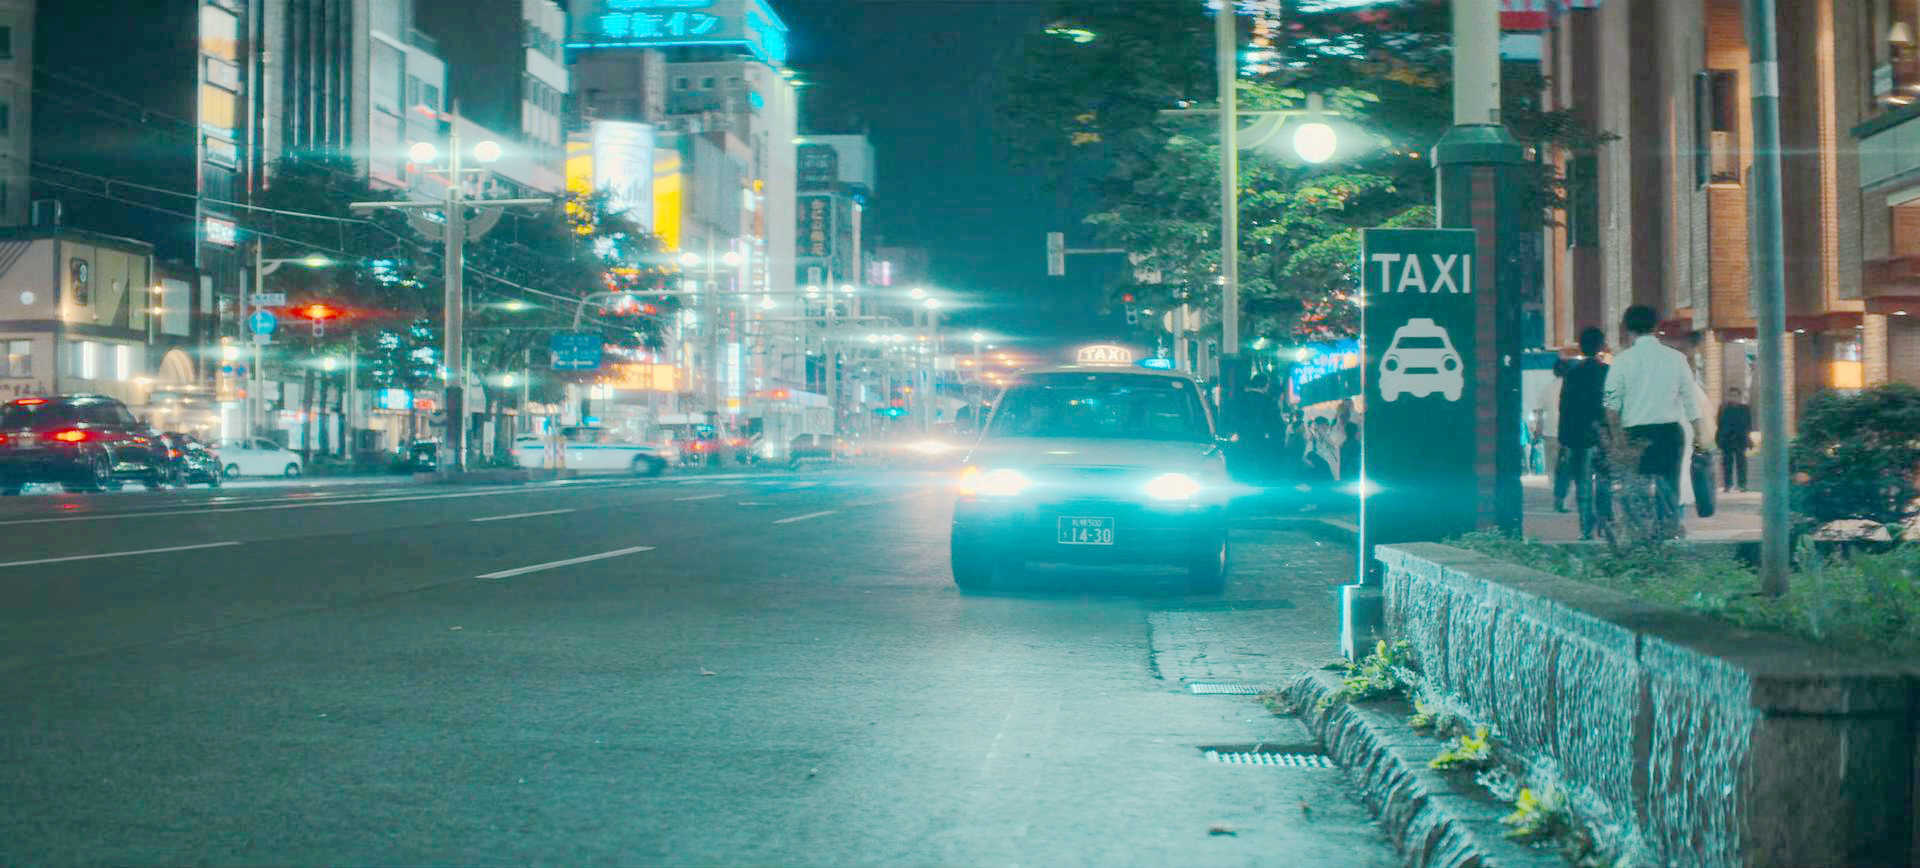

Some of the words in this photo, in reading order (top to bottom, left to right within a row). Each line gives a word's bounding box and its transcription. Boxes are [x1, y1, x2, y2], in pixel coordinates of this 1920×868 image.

[1371, 253, 1471, 293] TAXI
[1084, 348, 1127, 361] TAXI
[1072, 528, 1112, 543] 14-30
